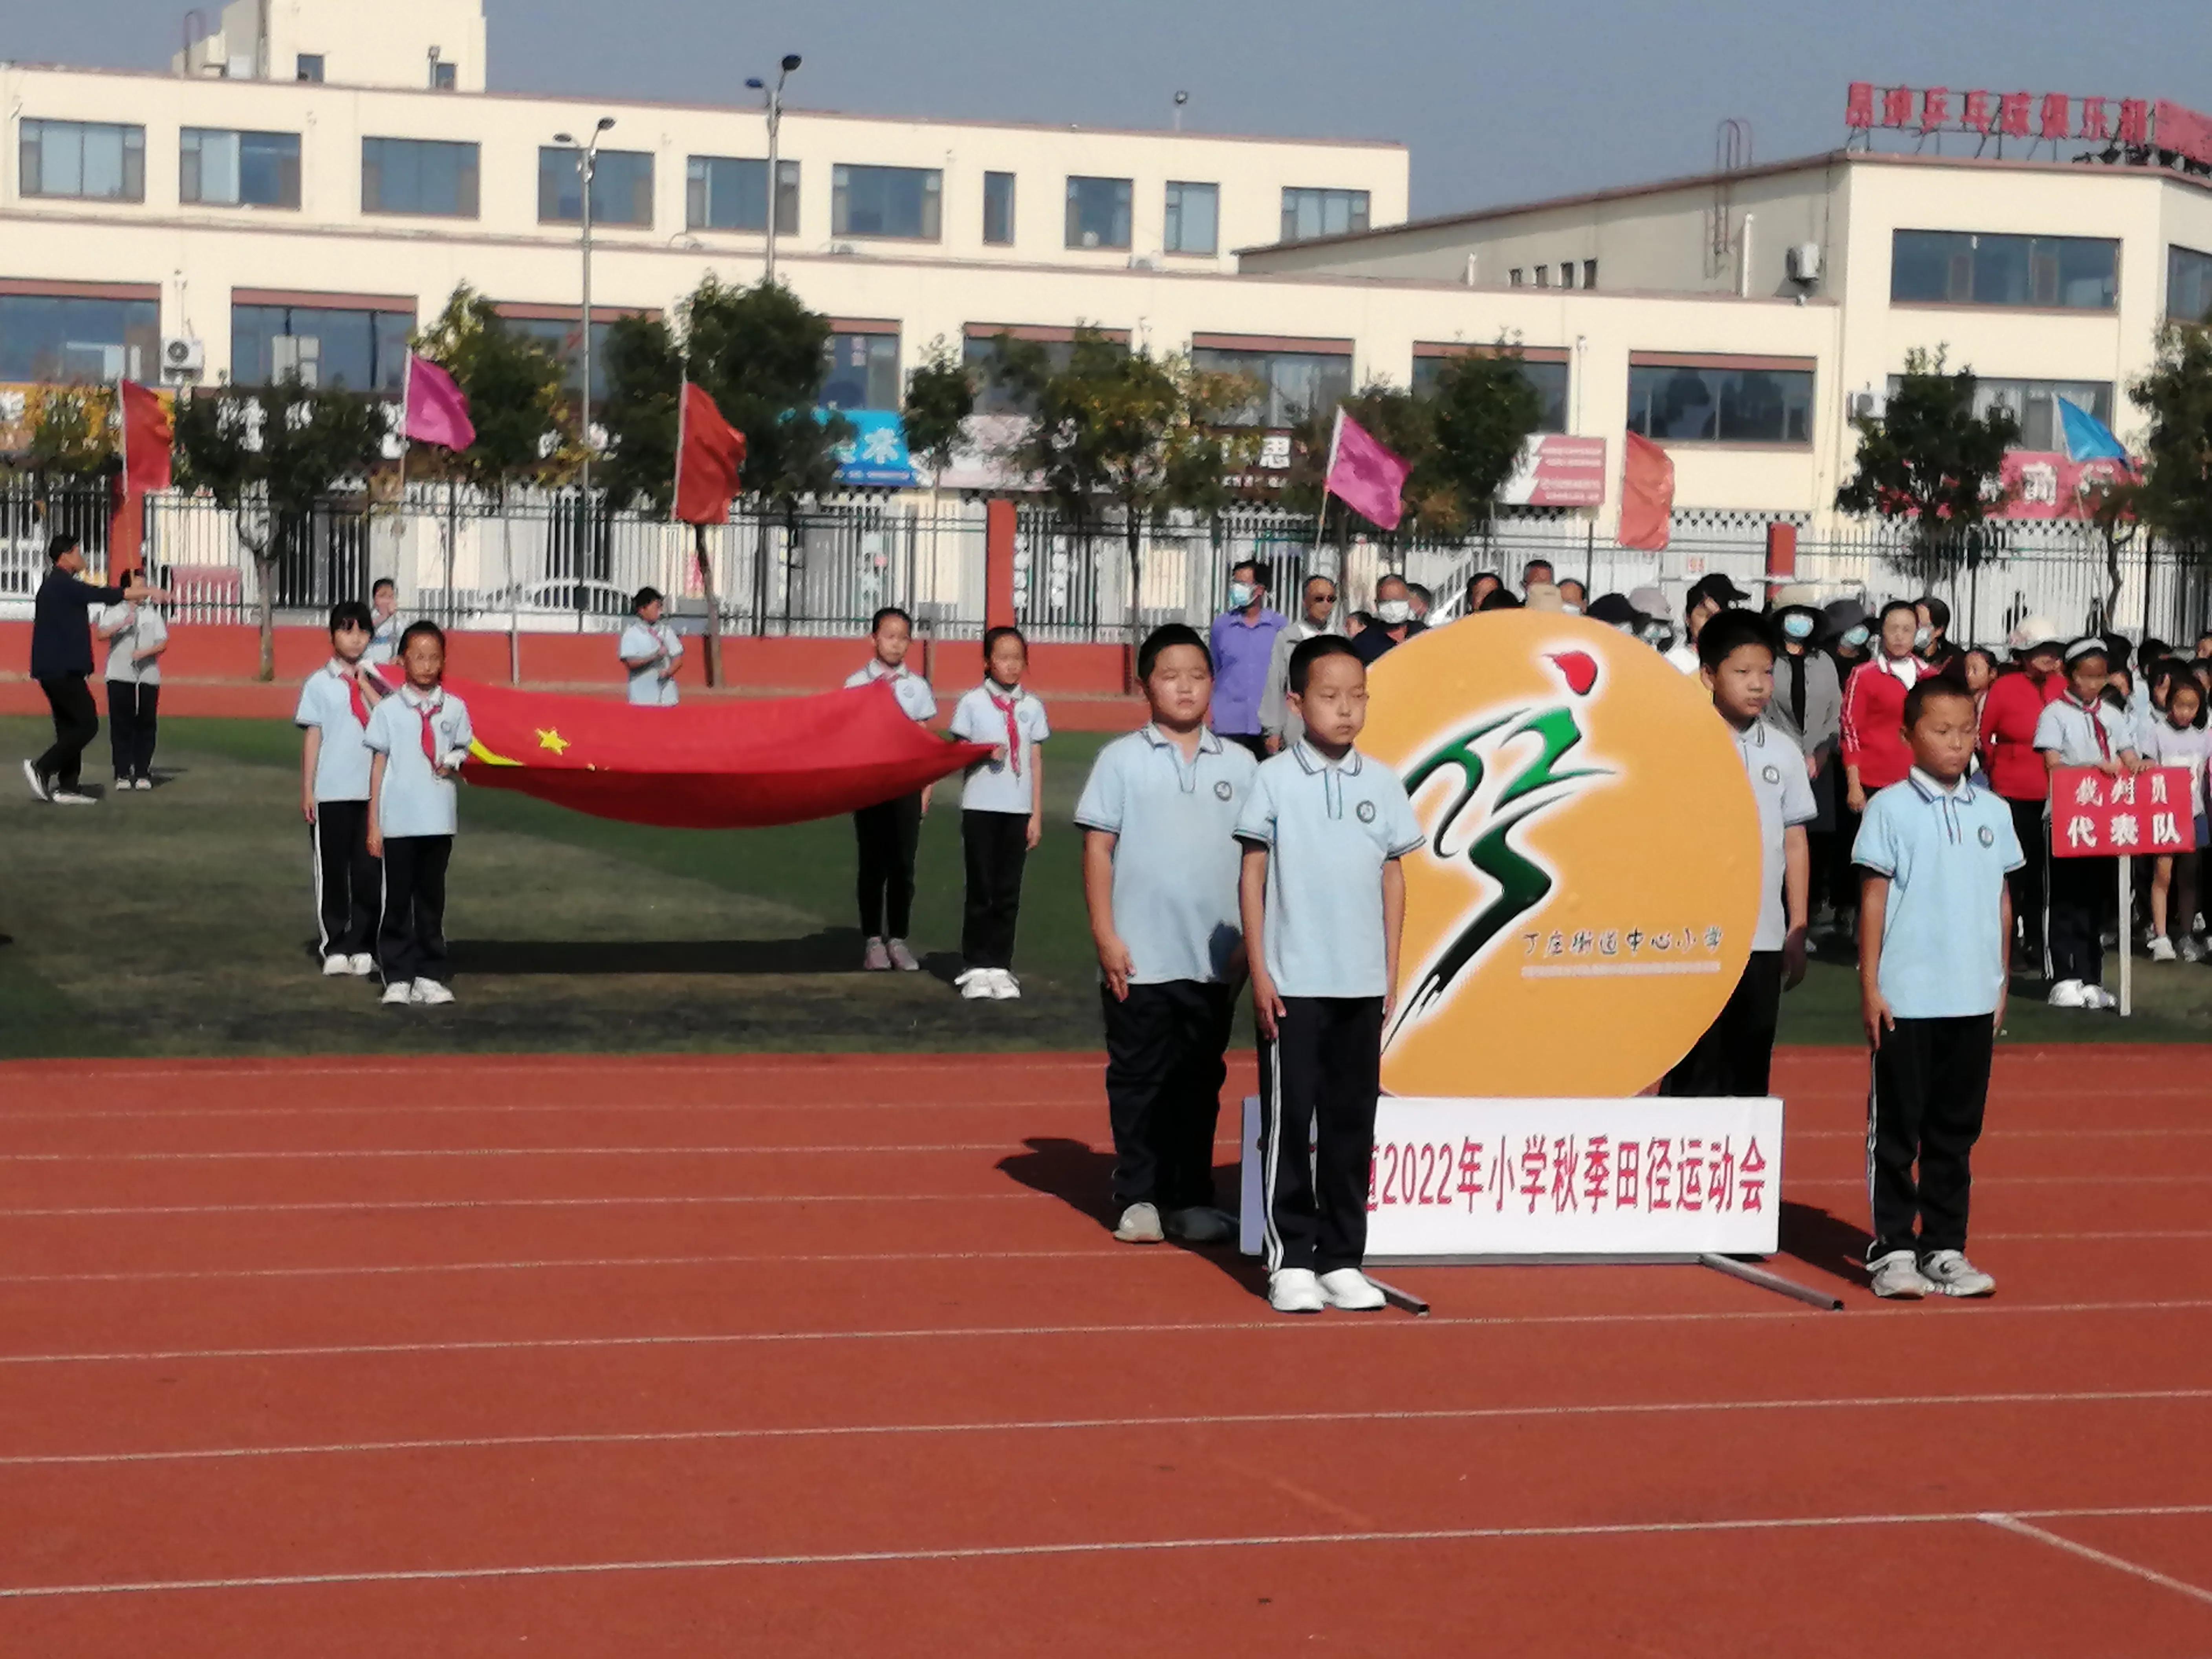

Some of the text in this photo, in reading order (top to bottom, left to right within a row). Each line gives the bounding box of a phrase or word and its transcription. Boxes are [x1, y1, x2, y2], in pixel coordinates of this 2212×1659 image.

[2067, 812, 2182, 848] 代表队
[1522, 926, 1723, 958] 丁庄街道中心小学
